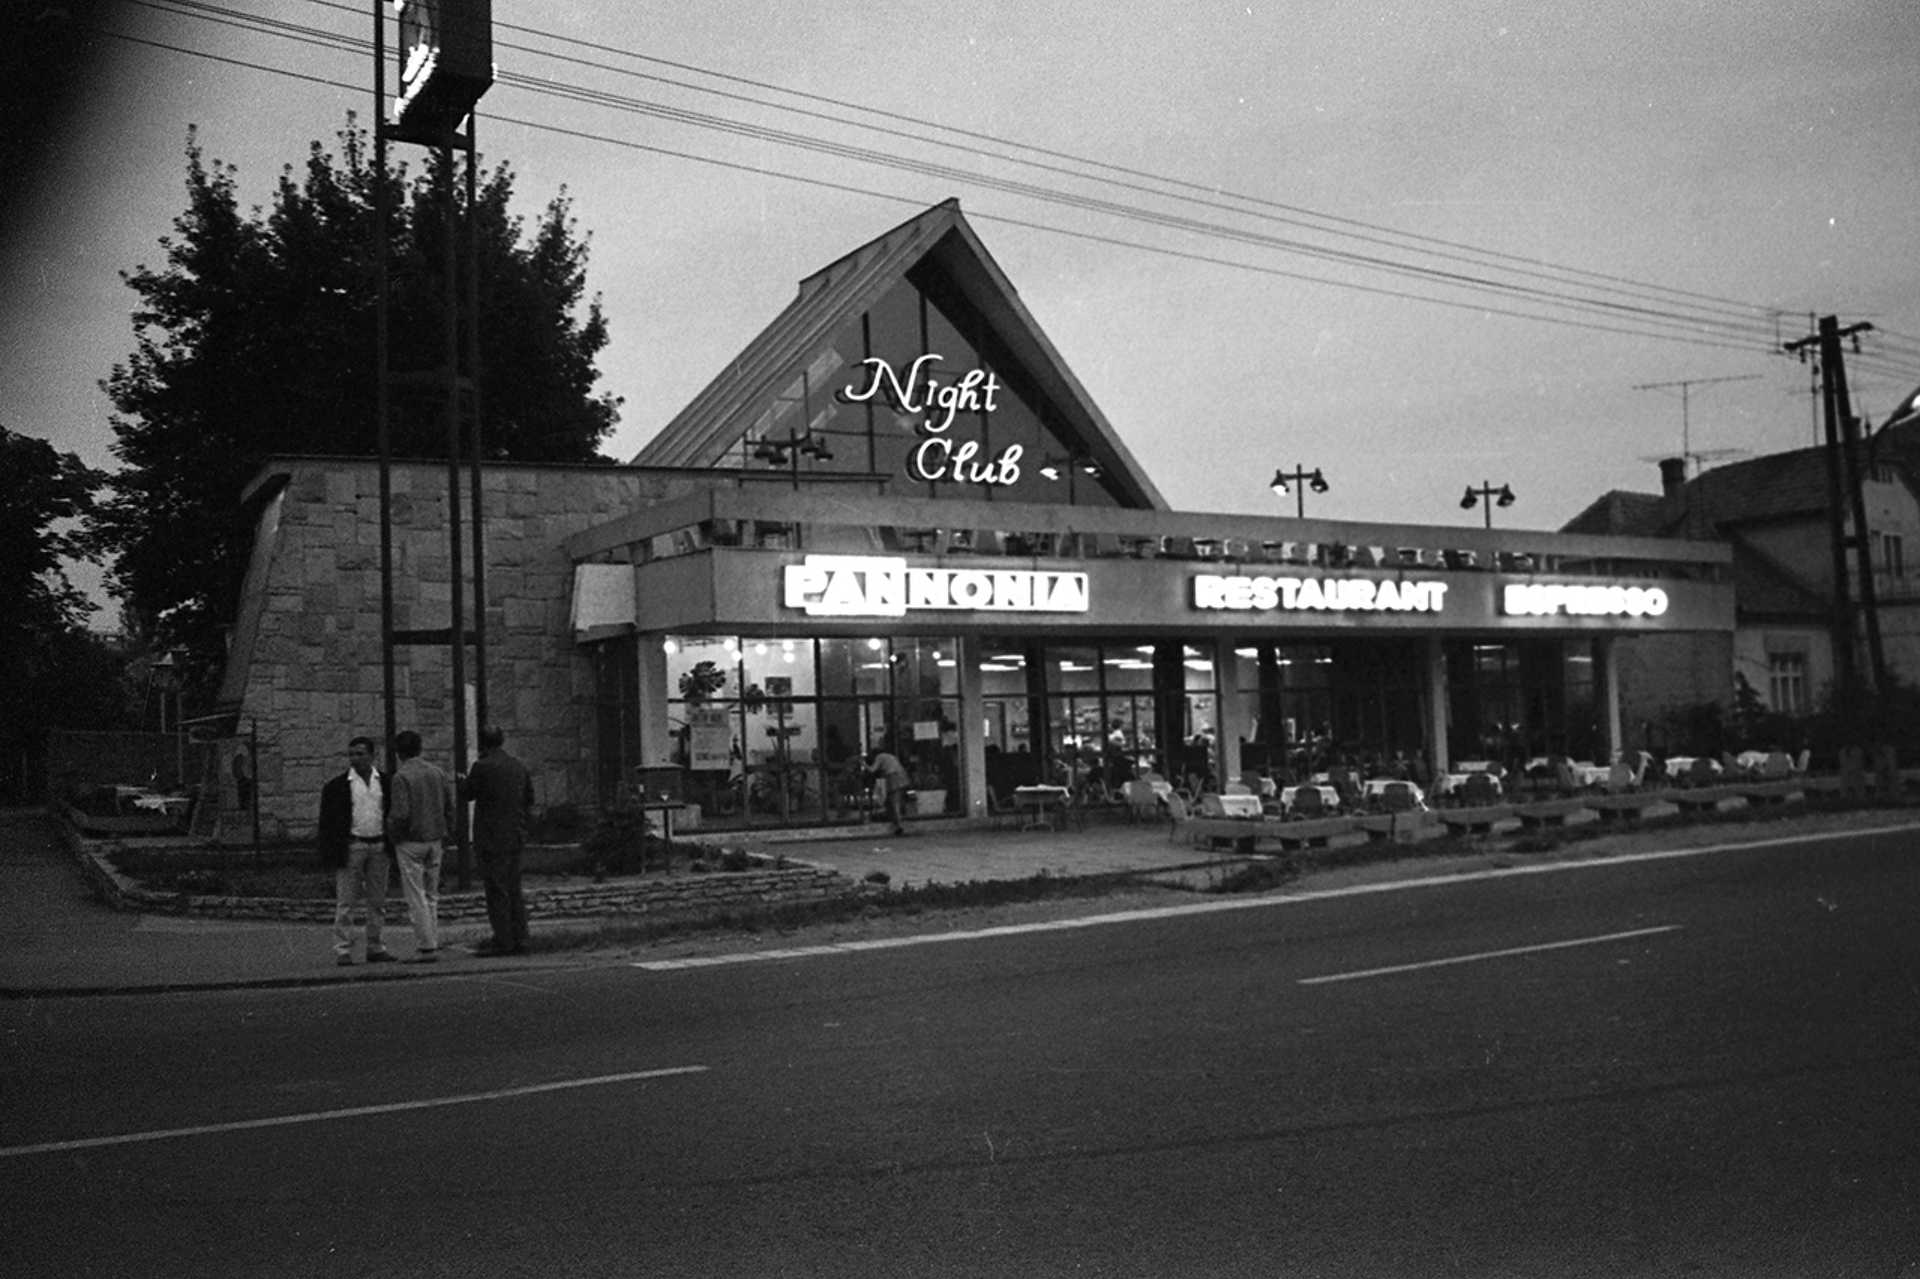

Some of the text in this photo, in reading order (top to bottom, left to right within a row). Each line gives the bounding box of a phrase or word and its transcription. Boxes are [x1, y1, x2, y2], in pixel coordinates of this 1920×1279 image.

[845, 354, 1000, 432] Night
[917, 438, 1023, 485] Club
[786, 557, 1088, 614] PANNONIA
[1195, 575, 1448, 611] RESTAURANT
